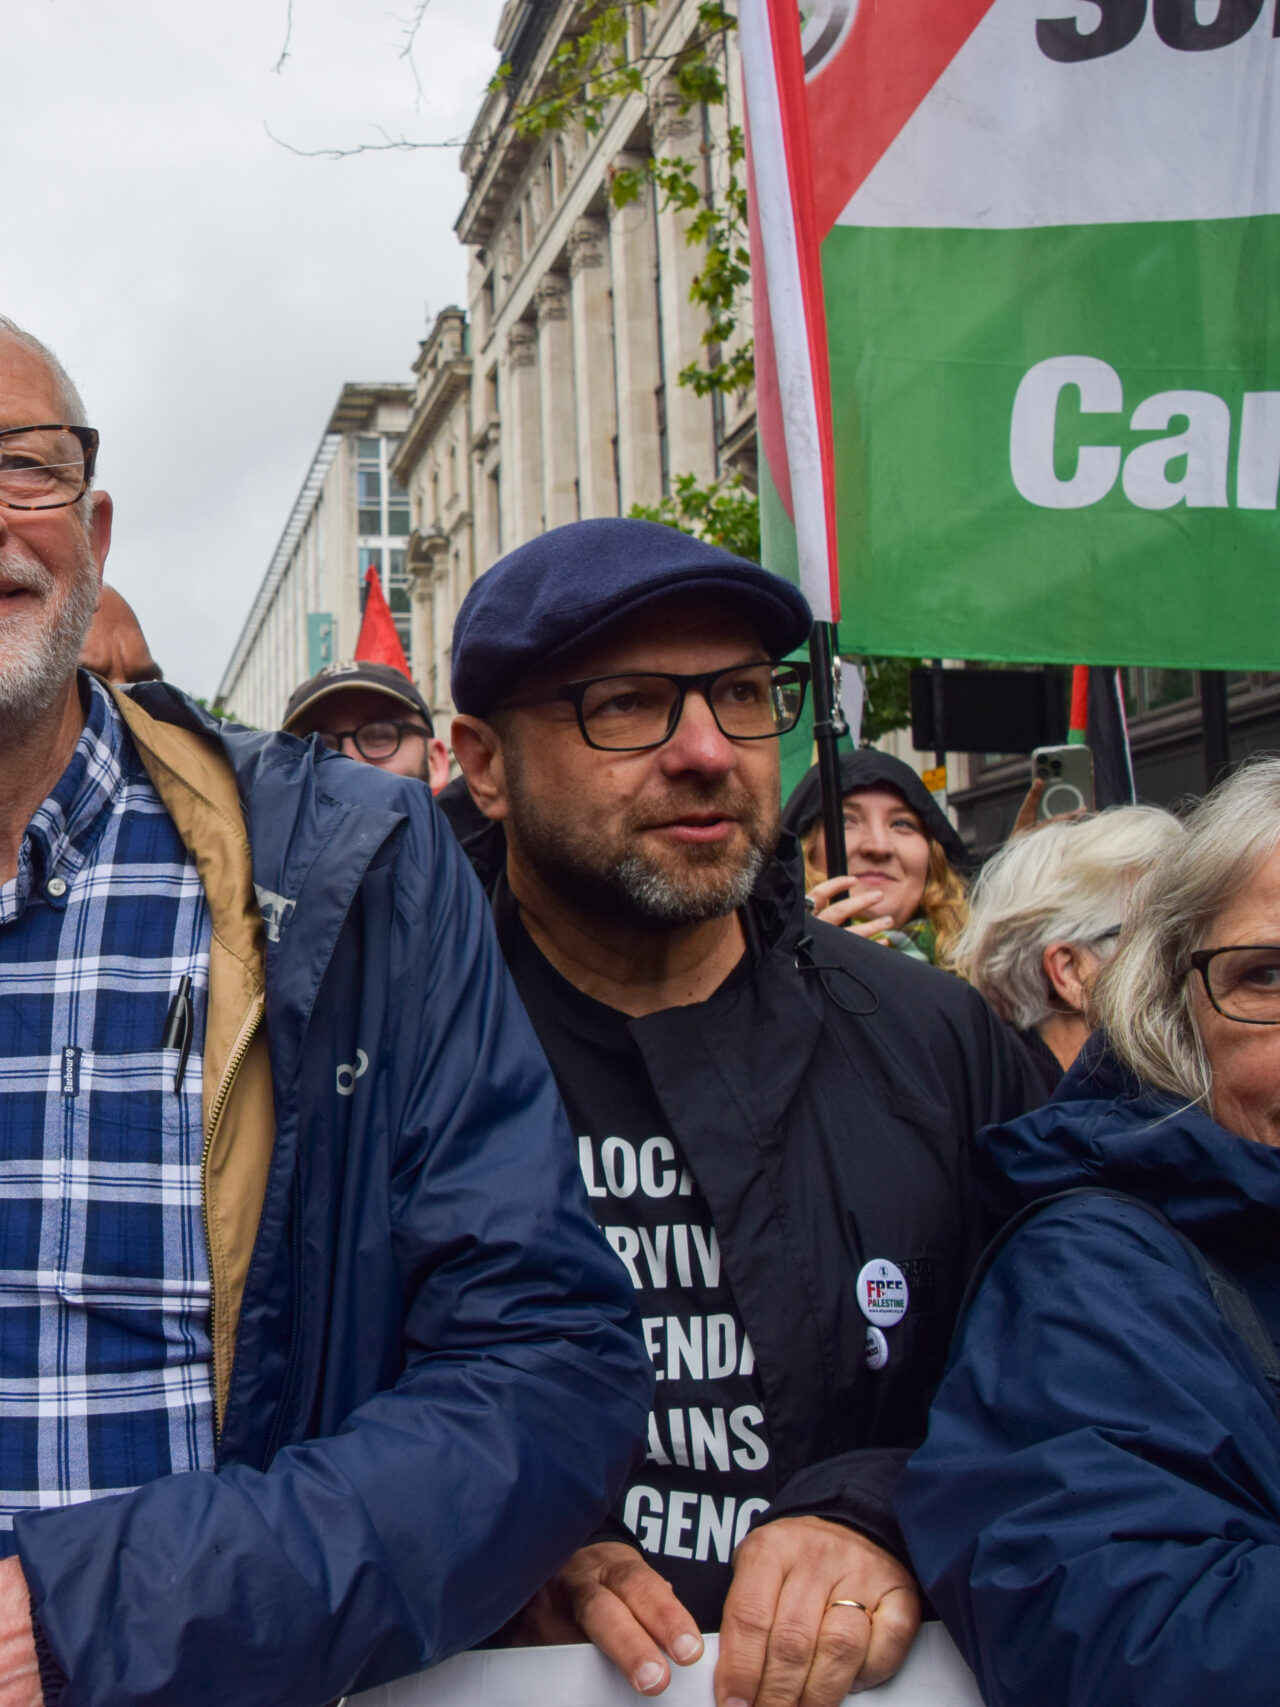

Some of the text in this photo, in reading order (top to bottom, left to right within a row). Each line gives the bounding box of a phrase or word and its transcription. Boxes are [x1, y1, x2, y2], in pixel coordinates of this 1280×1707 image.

[63, 1058, 74, 1092] Barbour
[598, 1224, 721, 1289] RVIV
[866, 1280, 902, 1298] FREE
[867, 1299, 904, 1308] PALESTINE
